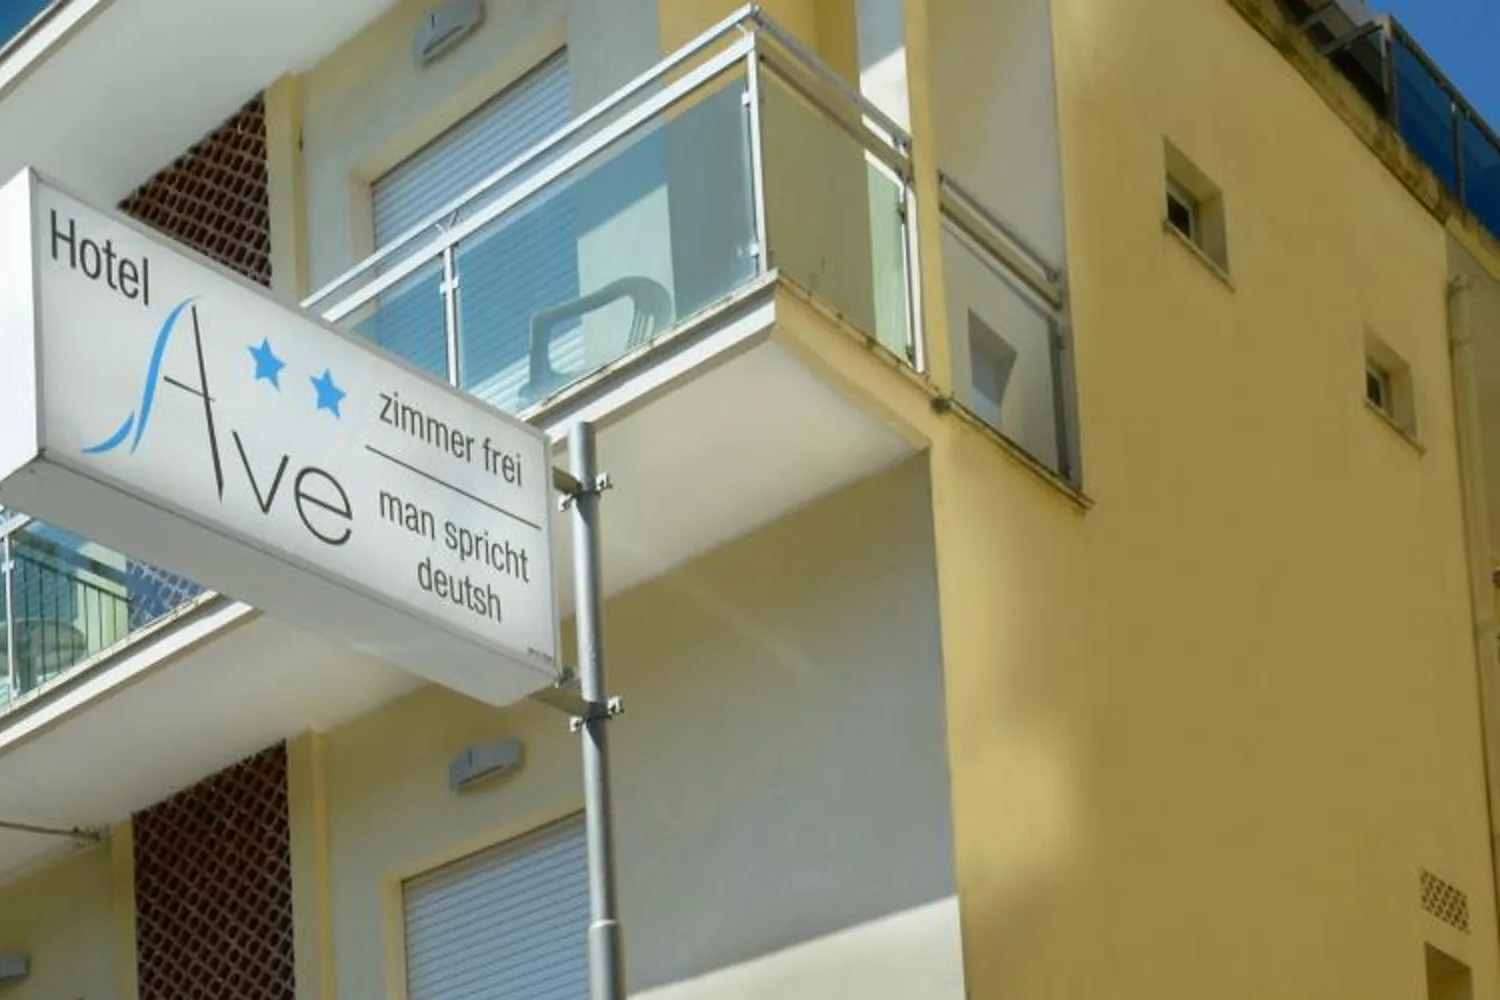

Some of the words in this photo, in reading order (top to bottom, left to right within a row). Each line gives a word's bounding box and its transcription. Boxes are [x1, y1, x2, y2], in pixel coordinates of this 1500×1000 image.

[51, 208, 149, 307] Hotel
[80, 295, 353, 546] Ave
[379, 391, 475, 463] zimmer
[483, 436, 522, 487] frei
[379, 489, 435, 540] man
[444, 520, 529, 584] spricht
[417, 556, 502, 624] deutsh
